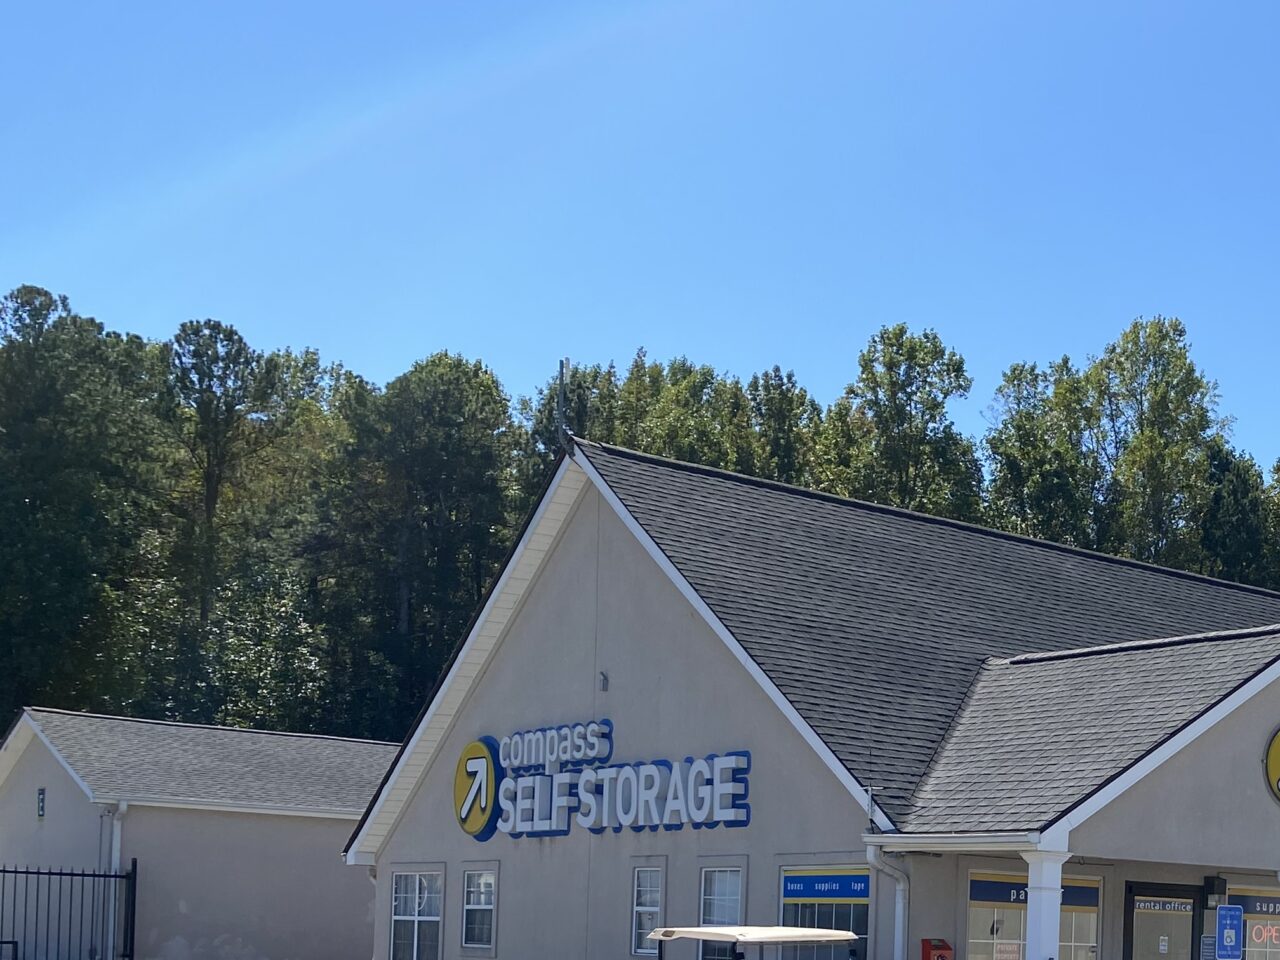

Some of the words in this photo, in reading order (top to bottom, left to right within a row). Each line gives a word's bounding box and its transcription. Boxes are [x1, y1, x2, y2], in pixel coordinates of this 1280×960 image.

[498, 721, 611, 775] compass
[496, 771, 578, 834] SELF
[576, 755, 749, 830] STORAGE
[787, 882, 804, 891] boxes
[815, 881, 839, 892] supplies
[851, 881, 865, 892] tape
[1136, 901, 1163, 910] rental
[1165, 902, 1191, 911] office
